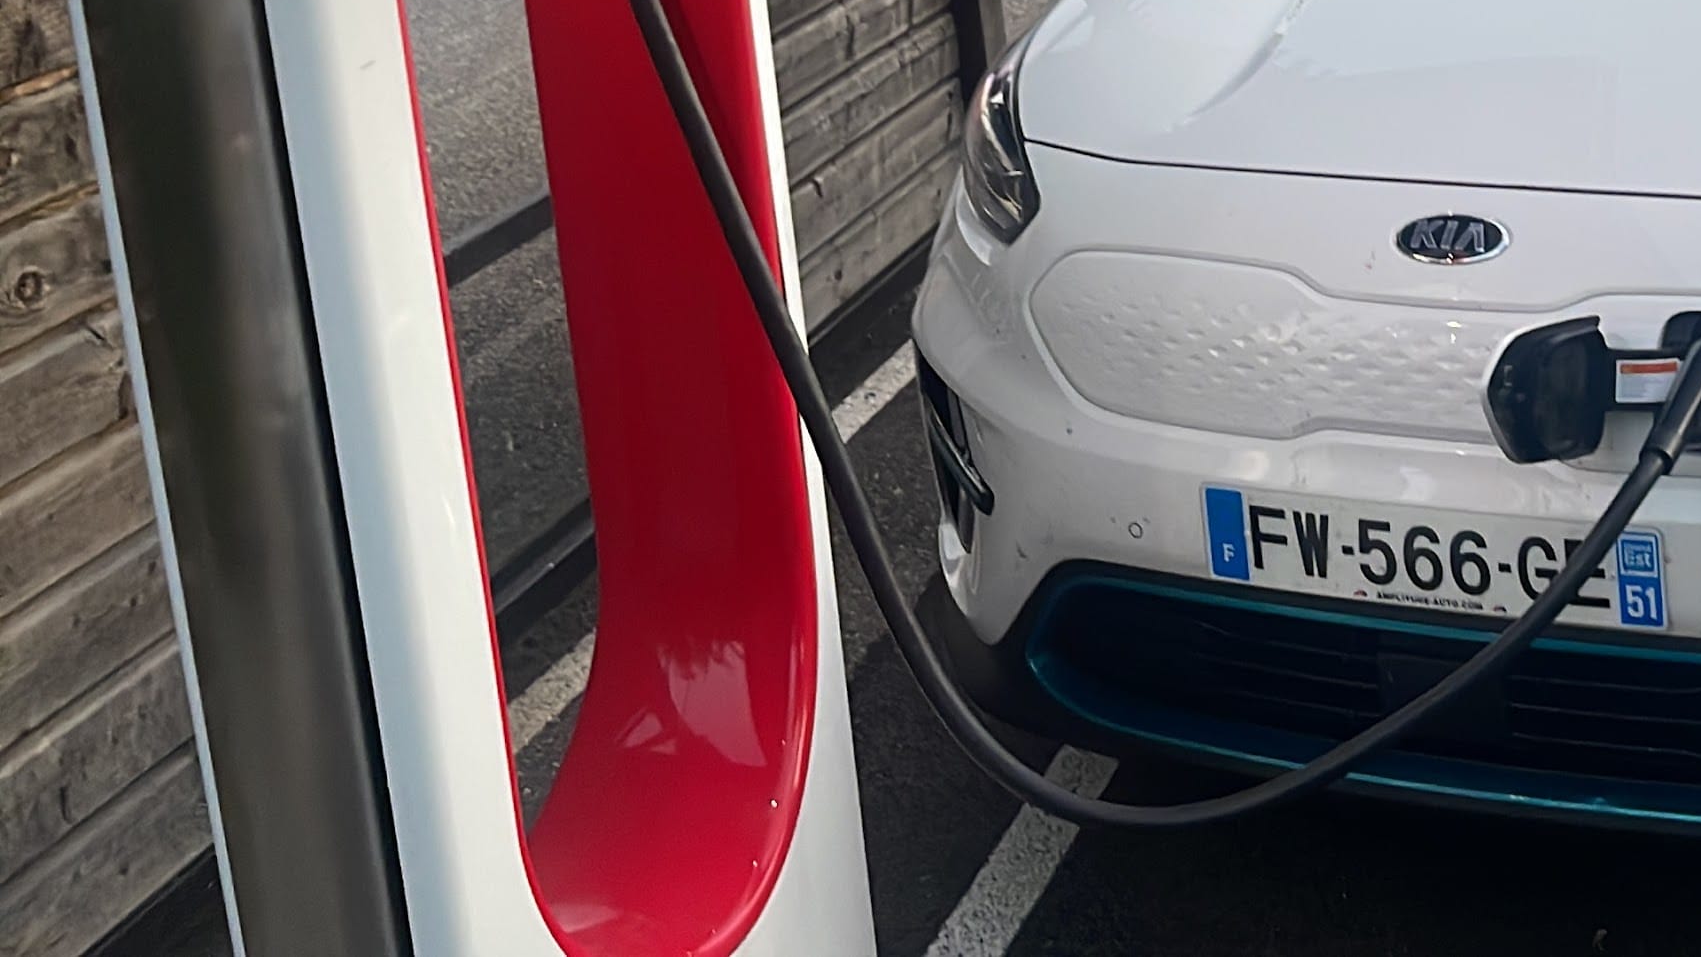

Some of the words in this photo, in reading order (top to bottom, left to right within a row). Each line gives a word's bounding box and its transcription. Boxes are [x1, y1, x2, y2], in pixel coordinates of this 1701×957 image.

[1410, 219, 1486, 254] KIA
[1222, 542, 1236, 563] F
[1625, 584, 1658, 620] 51
